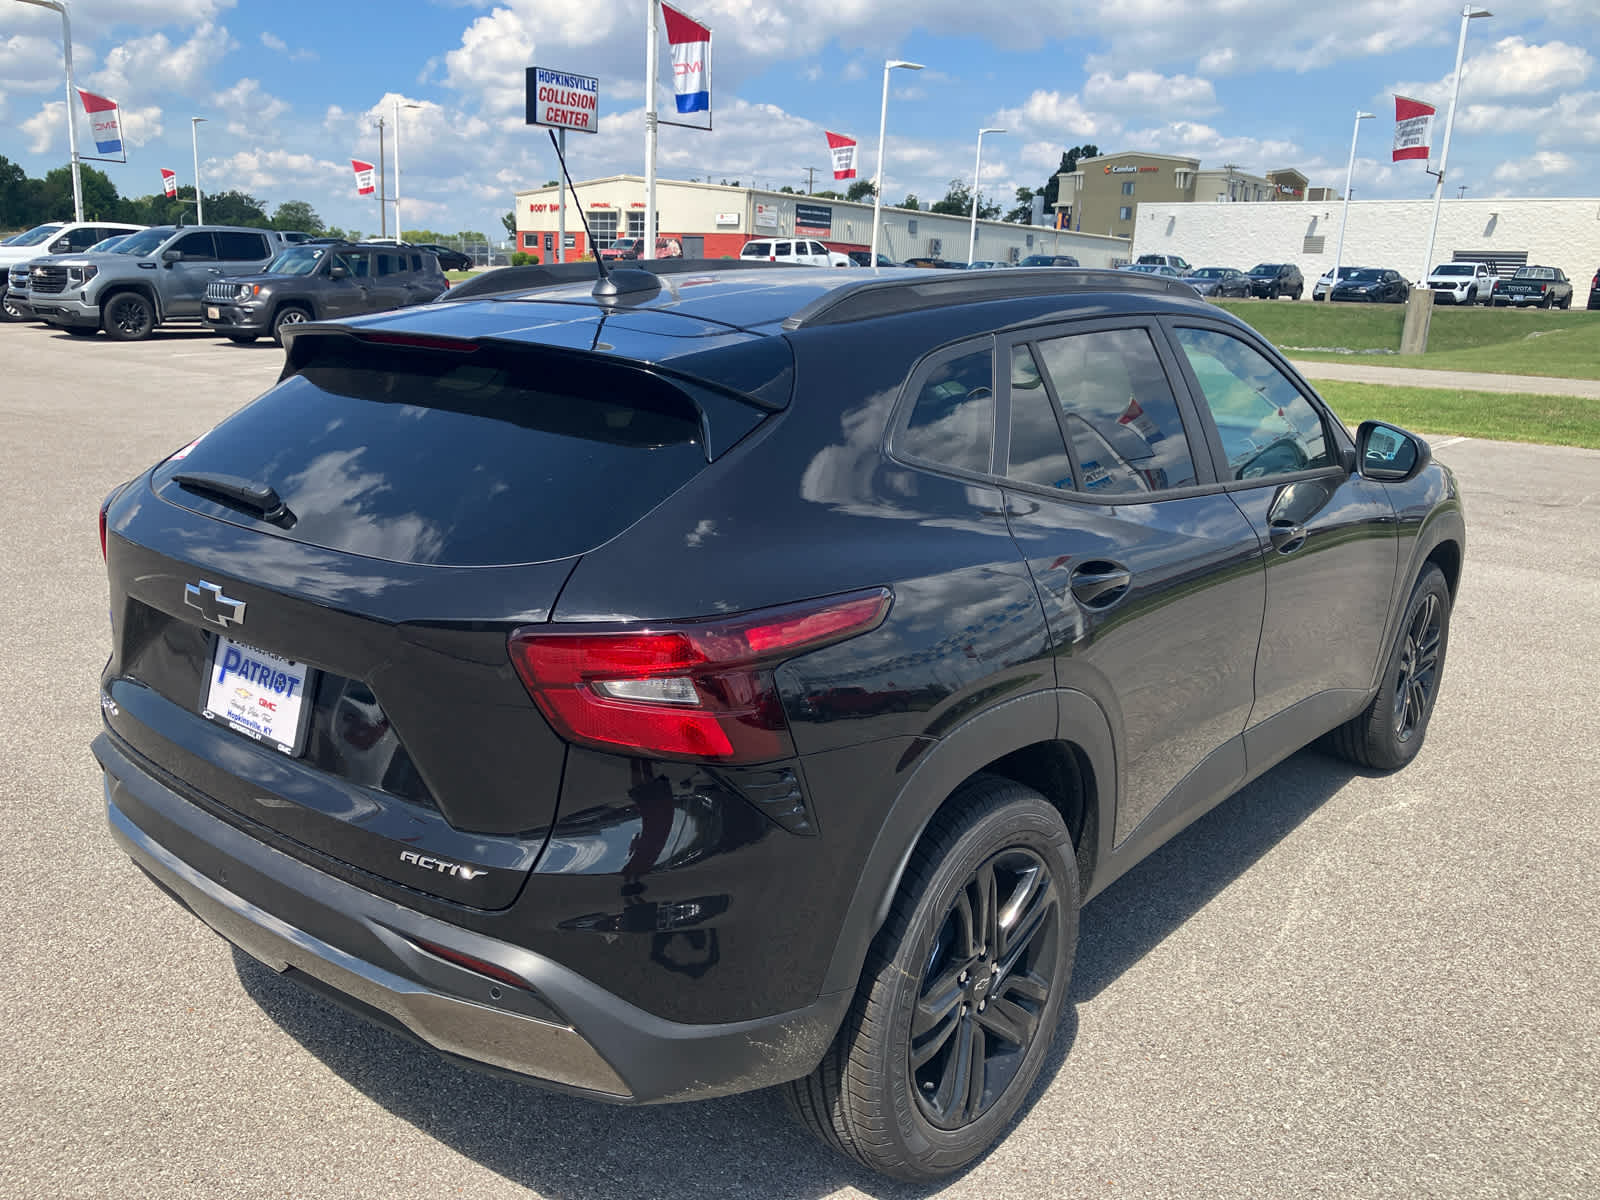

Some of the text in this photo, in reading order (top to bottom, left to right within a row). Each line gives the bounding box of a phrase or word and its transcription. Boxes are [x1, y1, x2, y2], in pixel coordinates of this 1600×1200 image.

[538, 70, 597, 92] HOPKINSVILLE
[538, 86, 597, 111] COLLISION
[545, 106, 589, 127] CENTER
[529, 203, 547, 213] BODY
[1507, 285, 1533, 293] TOYOTA
[217, 645, 301, 698] PATRIOT
[258, 697, 278, 712] GMC
[263, 726, 273, 737] KY
[400, 850, 489, 880] ACTIV
